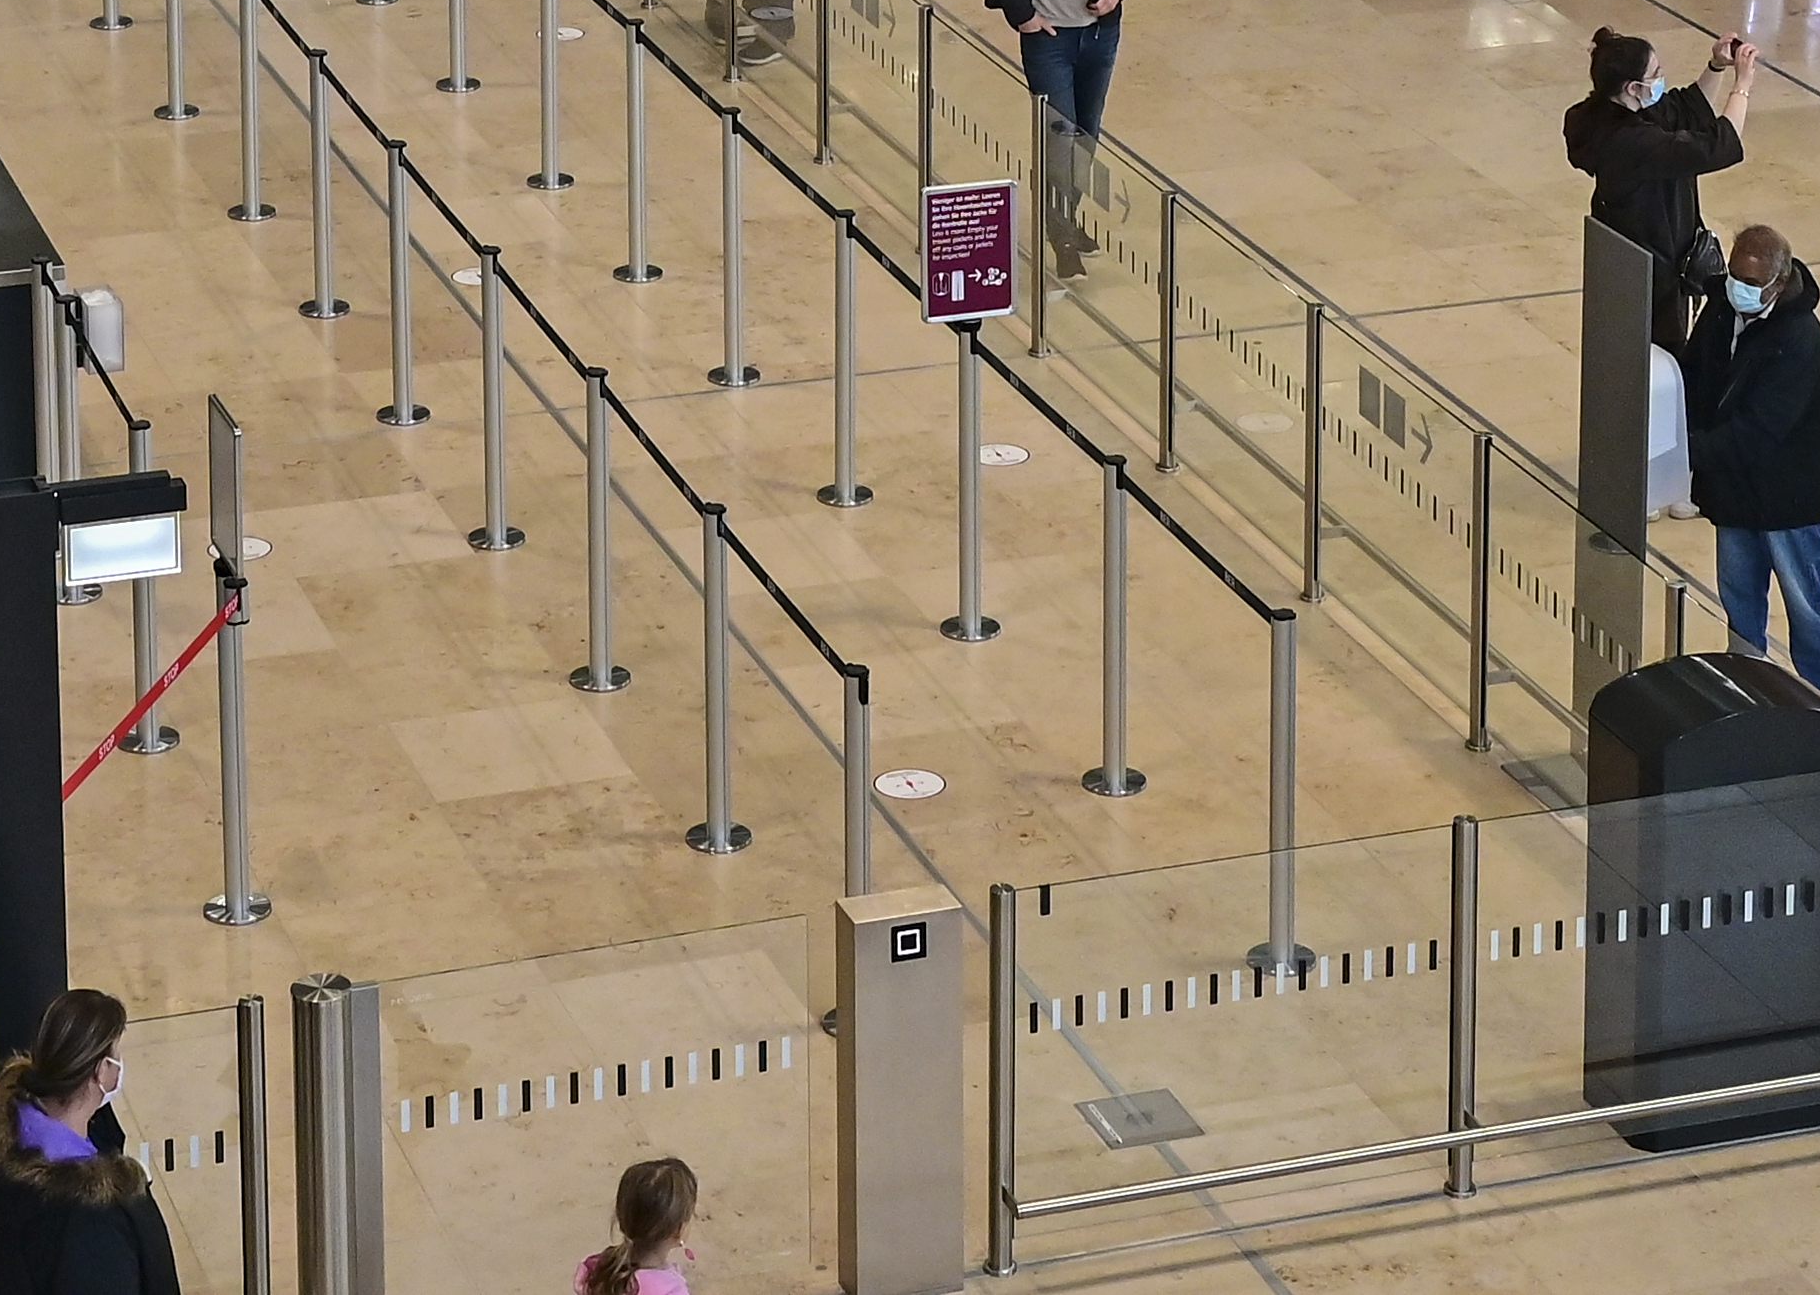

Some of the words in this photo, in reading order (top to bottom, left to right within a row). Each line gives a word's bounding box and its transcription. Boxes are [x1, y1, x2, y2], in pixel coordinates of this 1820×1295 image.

[225, 594, 239, 619] STOP
[163, 663, 179, 687] STOP
[98, 734, 115, 760] STOP
